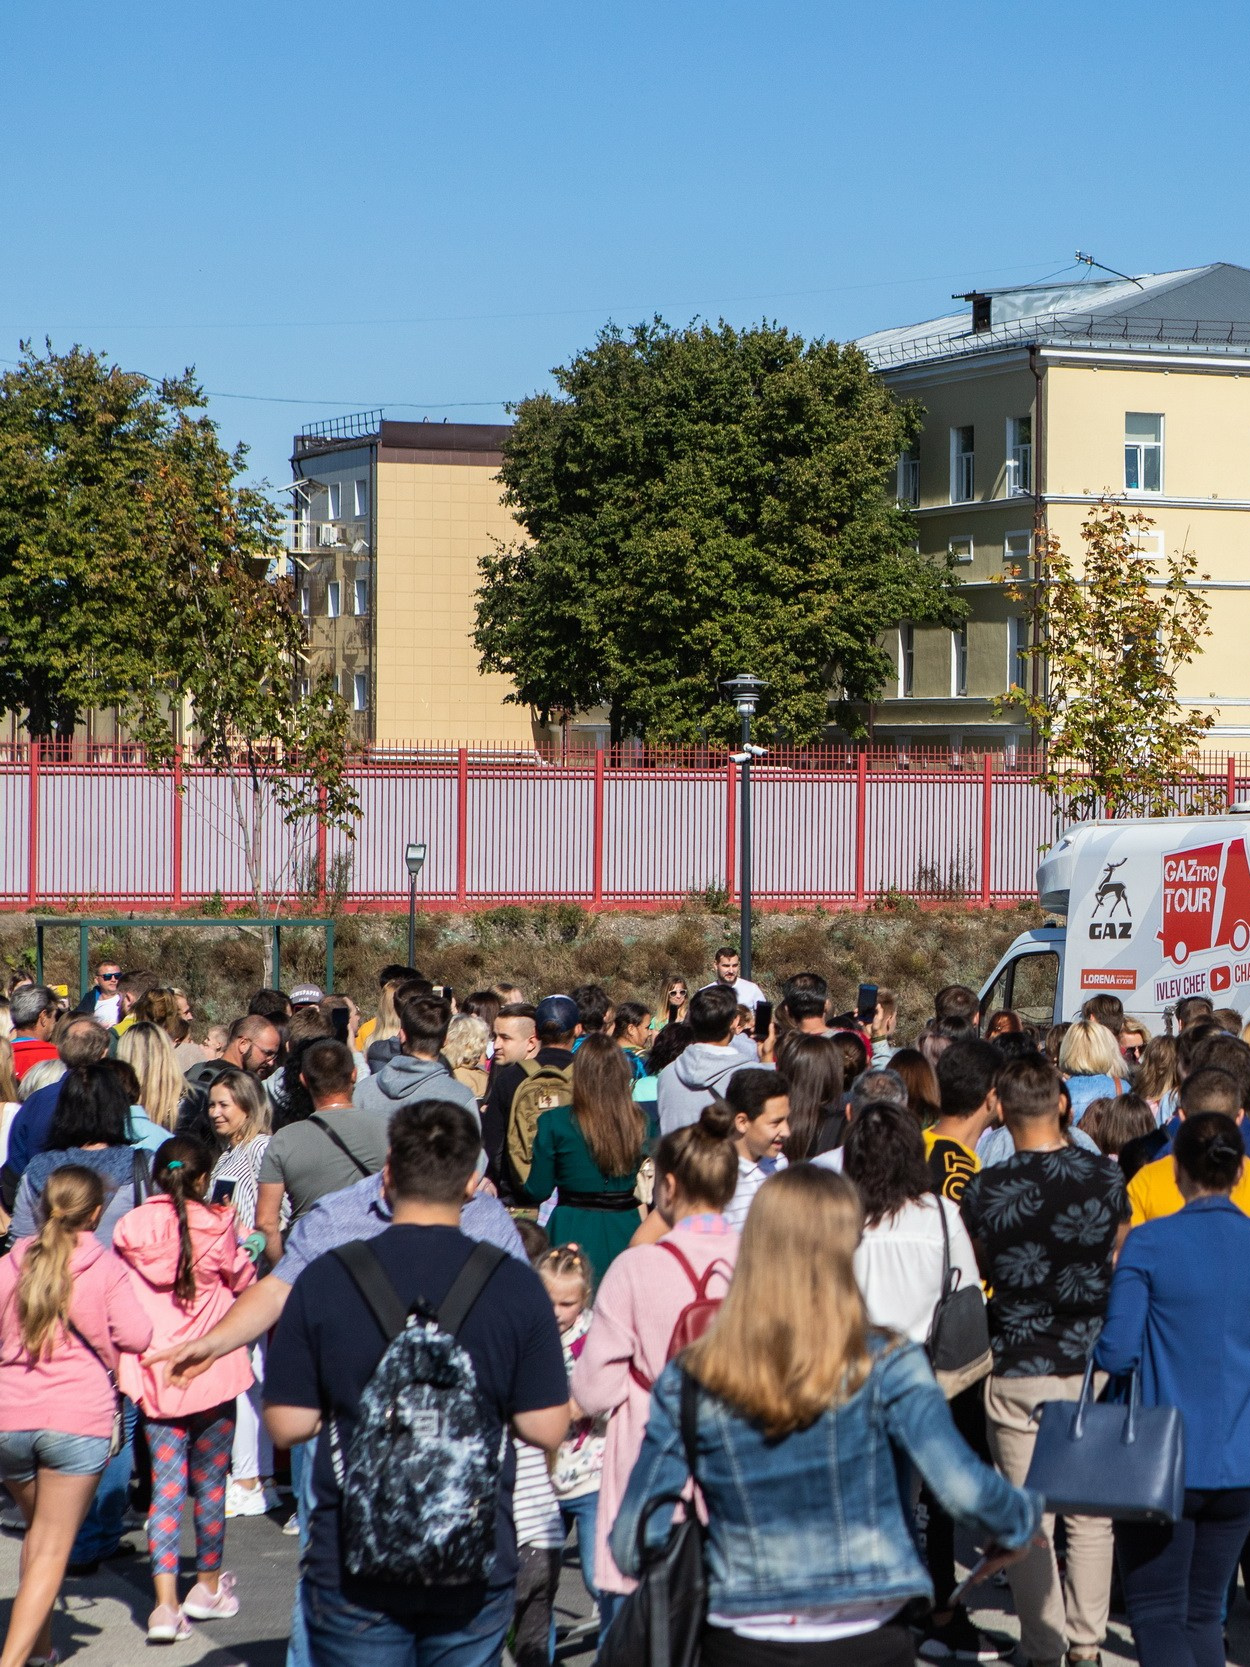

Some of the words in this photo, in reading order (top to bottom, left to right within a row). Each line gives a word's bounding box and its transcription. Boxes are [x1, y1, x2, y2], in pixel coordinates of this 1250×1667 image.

[1164, 887, 1211, 913] TOUR
[1089, 922, 1132, 939] GAZ
[1083, 974, 1116, 985] LORENA
[1156, 978, 1182, 1001] IVLEV
[1183, 972, 1206, 995] CHEF
